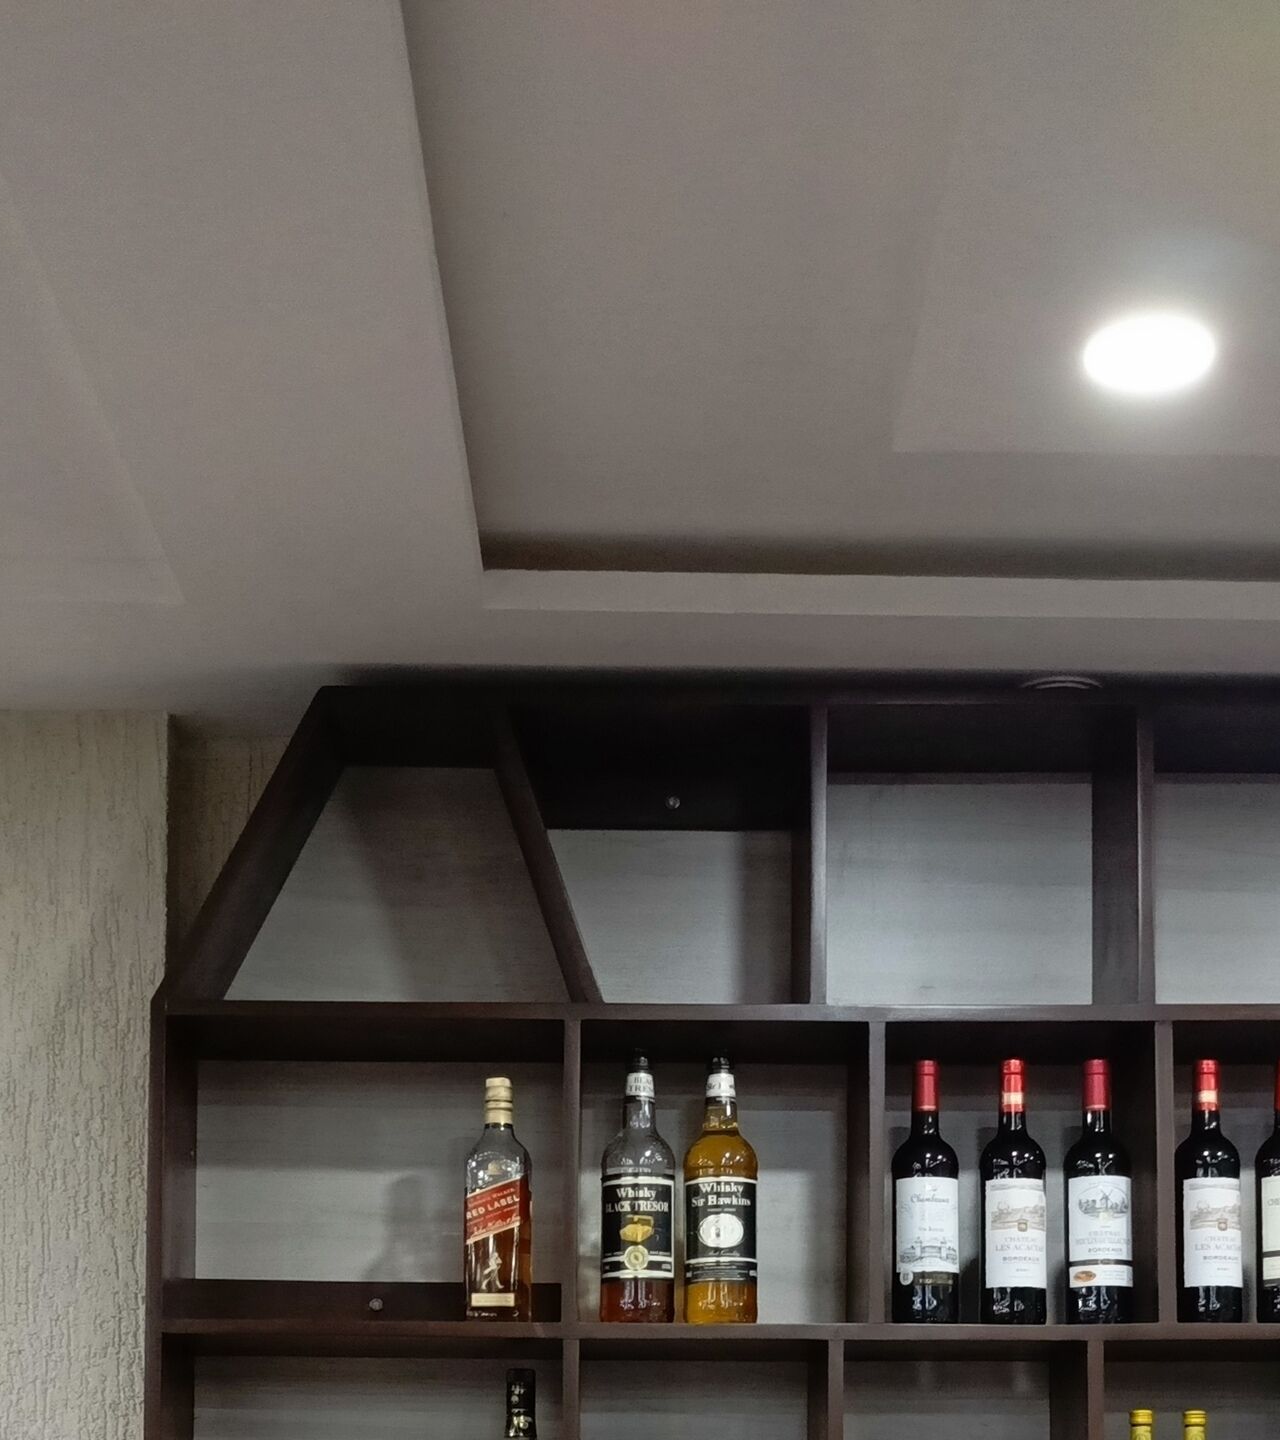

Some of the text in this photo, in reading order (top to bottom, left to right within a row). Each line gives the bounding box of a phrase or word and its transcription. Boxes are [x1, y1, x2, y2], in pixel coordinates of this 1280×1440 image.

[616, 1187, 657, 1200] Whisky
[698, 1182, 744, 1197] Whisky
[466, 1206, 486, 1220] RED
[487, 1194, 520, 1211] LABEL
[605, 1200, 669, 1213] BLACK TRESOR
[691, 1194, 751, 1207] Sir Hawkins
